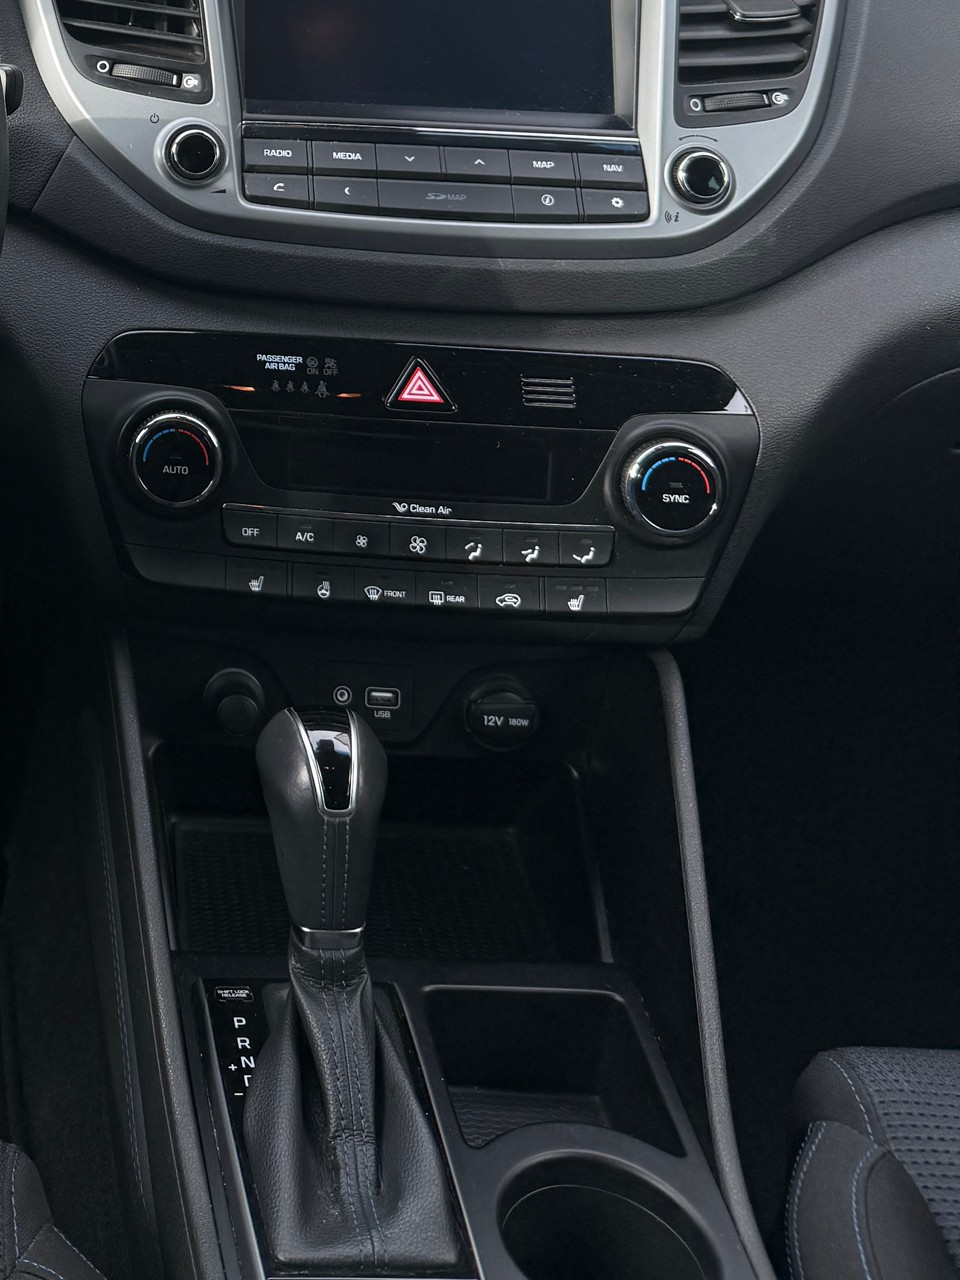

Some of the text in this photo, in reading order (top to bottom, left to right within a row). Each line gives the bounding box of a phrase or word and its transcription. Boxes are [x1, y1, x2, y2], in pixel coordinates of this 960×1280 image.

[263, 148, 292, 158] RADIO
[332, 151, 362, 161] MEDIA
[532, 160, 555, 169] MAP
[603, 163, 624, 172] NAV
[447, 193, 467, 201] MAP
[256, 353, 303, 364] PASSENGER
[264, 362, 296, 371] AIR BAG
[323, 368, 338, 376] OFF
[162, 465, 189, 475] AUTO
[662, 493, 690, 503] SYNC
[409, 503, 453, 515] Clean Air
[241, 527, 260, 537] OFF
[295, 531, 315, 542] A/C
[383, 590, 406, 598] FRONT
[446, 595, 465, 603] REAR
[373, 710, 391, 718] USB
[483, 714, 504, 727] 12V
[233, 1016, 247, 1029] P
[237, 1037, 251, 1049] R
[240, 1055, 256, 1068] N
